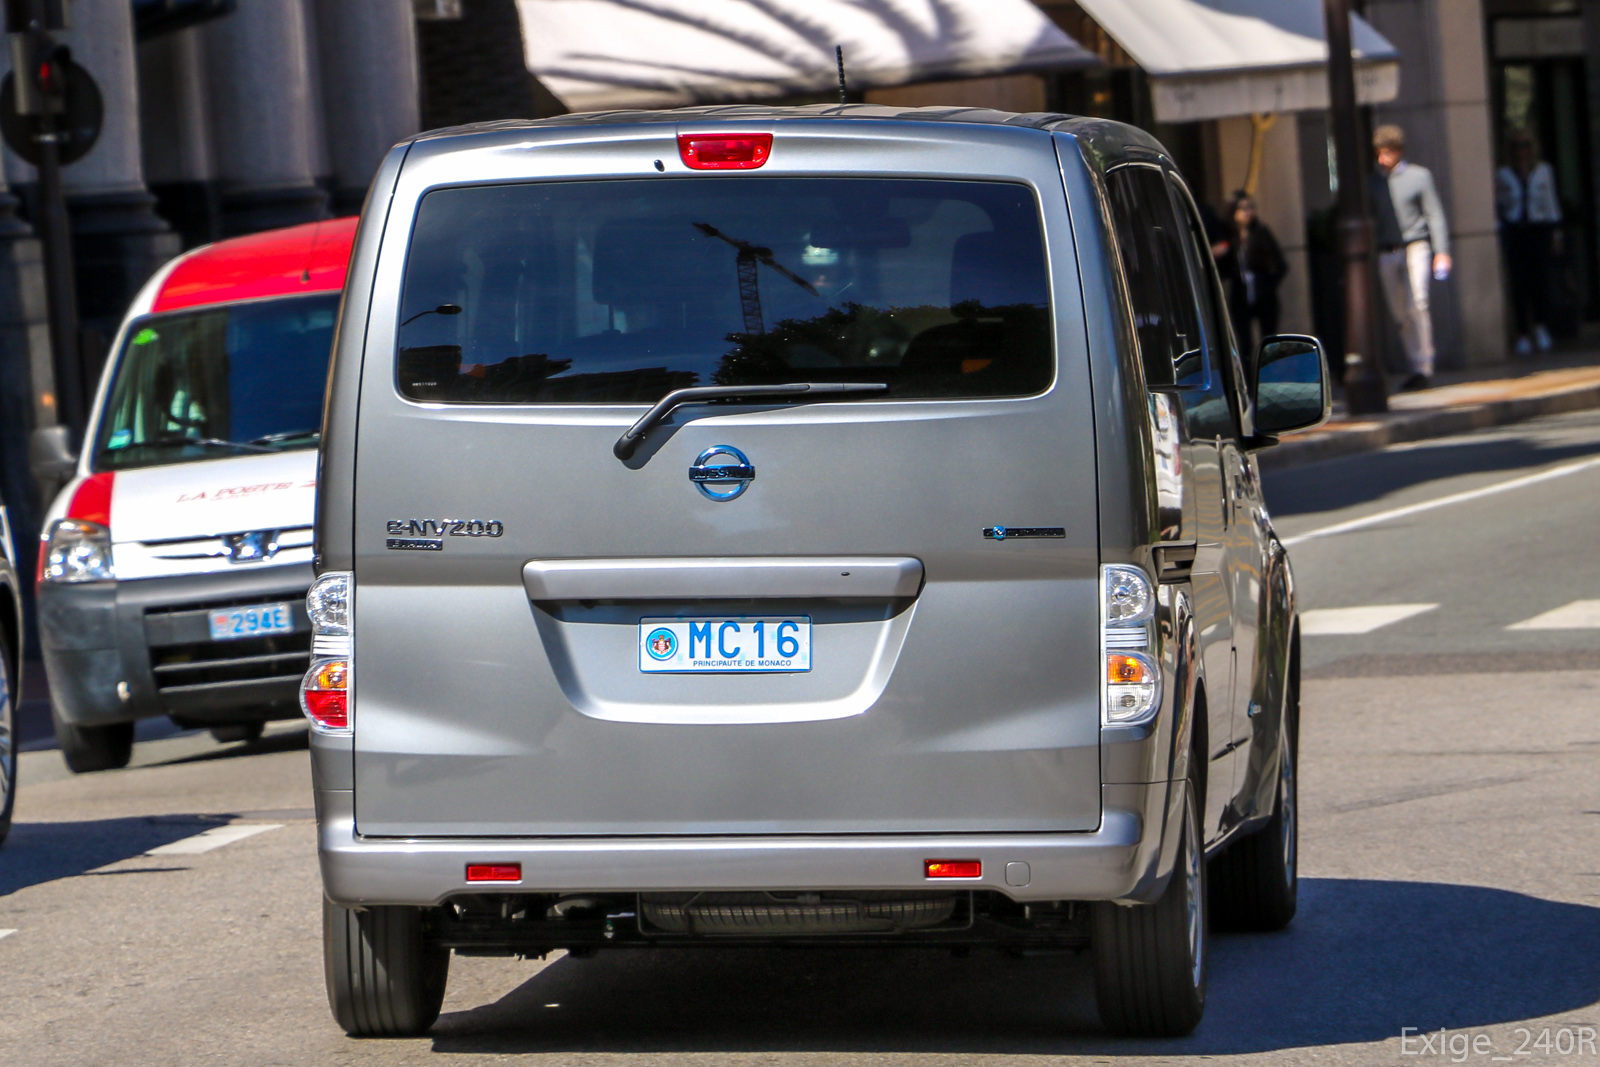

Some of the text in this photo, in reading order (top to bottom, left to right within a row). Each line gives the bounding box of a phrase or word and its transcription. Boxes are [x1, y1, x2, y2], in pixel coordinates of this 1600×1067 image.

[176, 491, 207, 503] LA
[214, 481, 294, 497] POSTE
[386, 518, 504, 538] e-NV200
